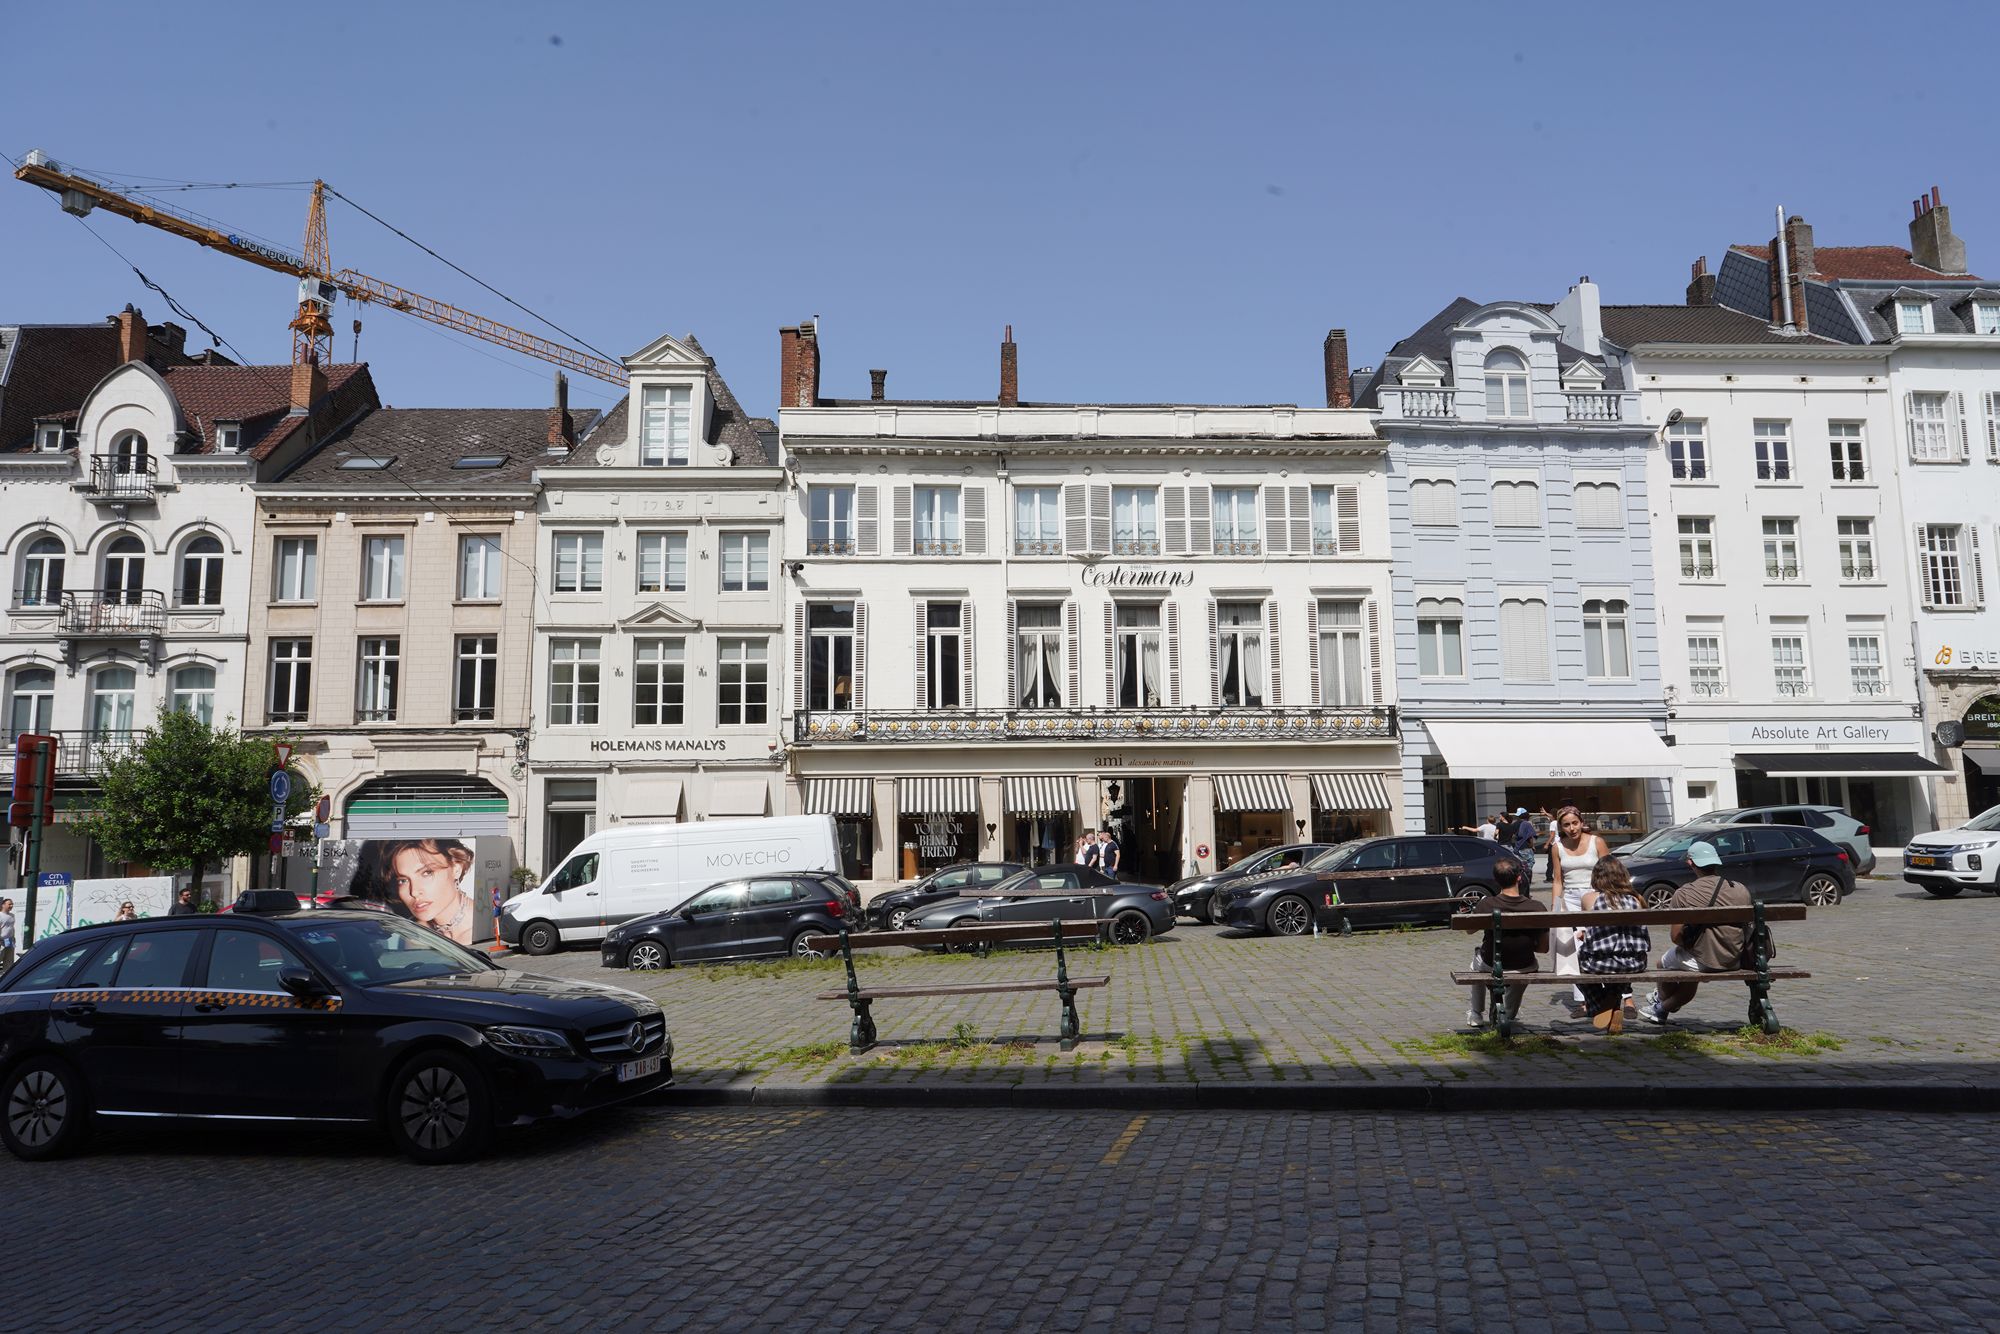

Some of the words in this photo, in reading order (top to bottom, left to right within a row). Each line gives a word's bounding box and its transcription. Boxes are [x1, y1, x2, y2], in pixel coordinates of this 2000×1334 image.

[1959, 650, 2000, 664] BRE
[1967, 713, 1999, 721] BREIT
[1752, 726, 1809, 739] Absolute
[1817, 726, 1838, 738] Art
[1843, 725, 1889, 740] Gallery
[591, 740, 662, 751] HOLEMANS
[665, 740, 726, 751] MANALYS
[1094, 753, 1123, 767] ami
[1549, 768, 1566, 777] dinh
[276, 807, 283, 820] P
[923, 811, 956, 823] THANK
[914, 823, 937, 835] YOU
[939, 823, 963, 834] FOR
[920, 835, 948, 846] BEING
[951, 835, 958, 846] A
[300, 848, 348, 857] MESIKA
[921, 846, 957, 858] FRIEND
[706, 850, 790, 867] MOVECHO
